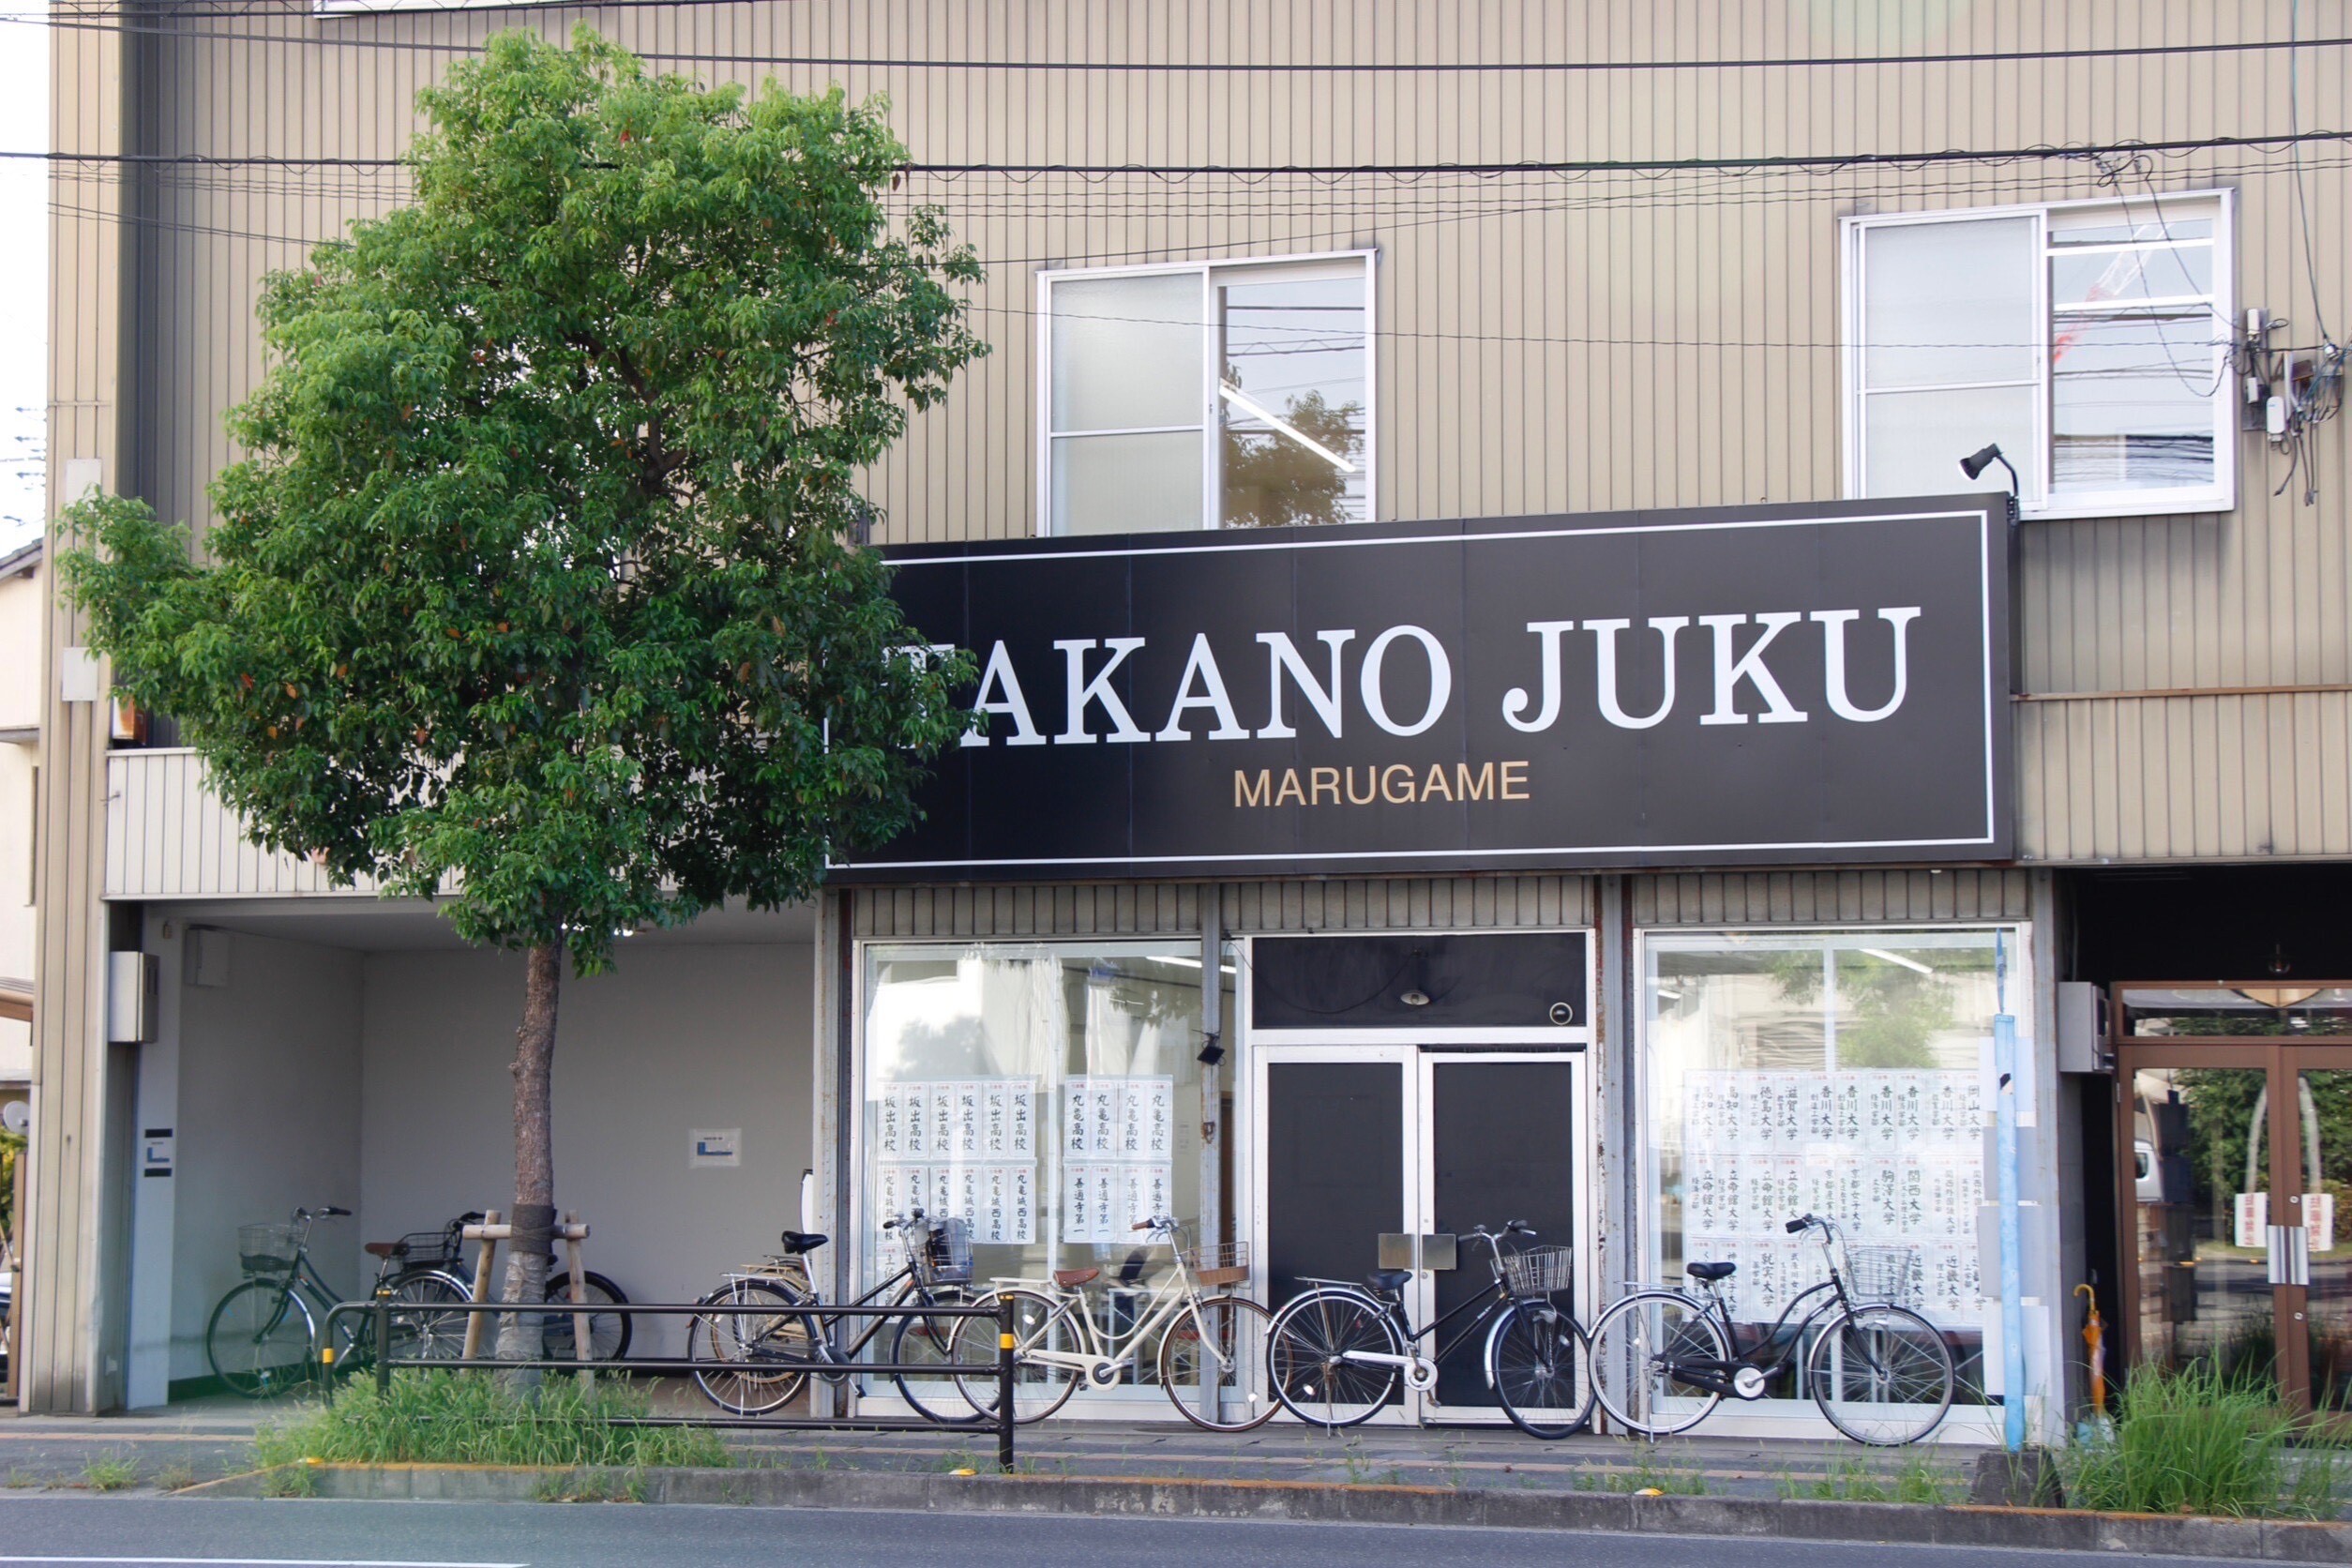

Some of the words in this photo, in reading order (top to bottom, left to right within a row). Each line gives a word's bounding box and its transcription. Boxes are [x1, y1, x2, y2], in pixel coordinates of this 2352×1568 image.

[1502, 606, 1922, 733] JUKU
[1233, 759, 1530, 807] MARUGAME
[884, 1095, 896, 1151] 坂出高校
[910, 1095, 921, 1151] 坂出高校
[938, 1095, 949, 1151] 坂出高校
[962, 1095, 974, 1151] 坂出高校
[990, 1095, 1002, 1151] 坂出高校
[1015, 1095, 1027, 1151] 坂出高校
[1071, 1094, 1084, 1151] 丸亀高校
[1096, 1094, 1109, 1151] 丸亀高校
[1125, 1094, 1139, 1151] 丸亀高校
[1151, 1094, 1164, 1151] 丸亀高校
[1726, 1086, 1738, 1140] 高知大学
[1761, 1086, 1772, 1140] 徳島大学
[1786, 1086, 1798, 1140] 滋賀大学
[1821, 1085, 1833, 1140] 香川大学
[1847, 1085, 1860, 1140] 香川大学
[1881, 1085, 1893, 1140] 香川大学
[1907, 1085, 1921, 1140] 香川大学
[1942, 1085, 1954, 1140] 香川大学
[1968, 1085, 1981, 1140] 岡山大学
[991, 1175, 1002, 1240] 丸亀城西高校
[1017, 1174, 1027, 1240] 丸亀城西高校
[1074, 1177, 1084, 1232] 善通寺第一
[1098, 1177, 1108, 1232] 善通寺第一
[1702, 1169, 1714, 1230] 立命館大学
[1727, 1169, 1739, 1231] 立命館大学
[1762, 1170, 1773, 1231] 立命館大学
[1907, 1169, 1922, 1225] 関西大学
[1726, 1252, 1737, 1314] 神女子大学
[1762, 1253, 1774, 1308] 就実大学
[1946, 1255, 1959, 1311] 近畿大学
